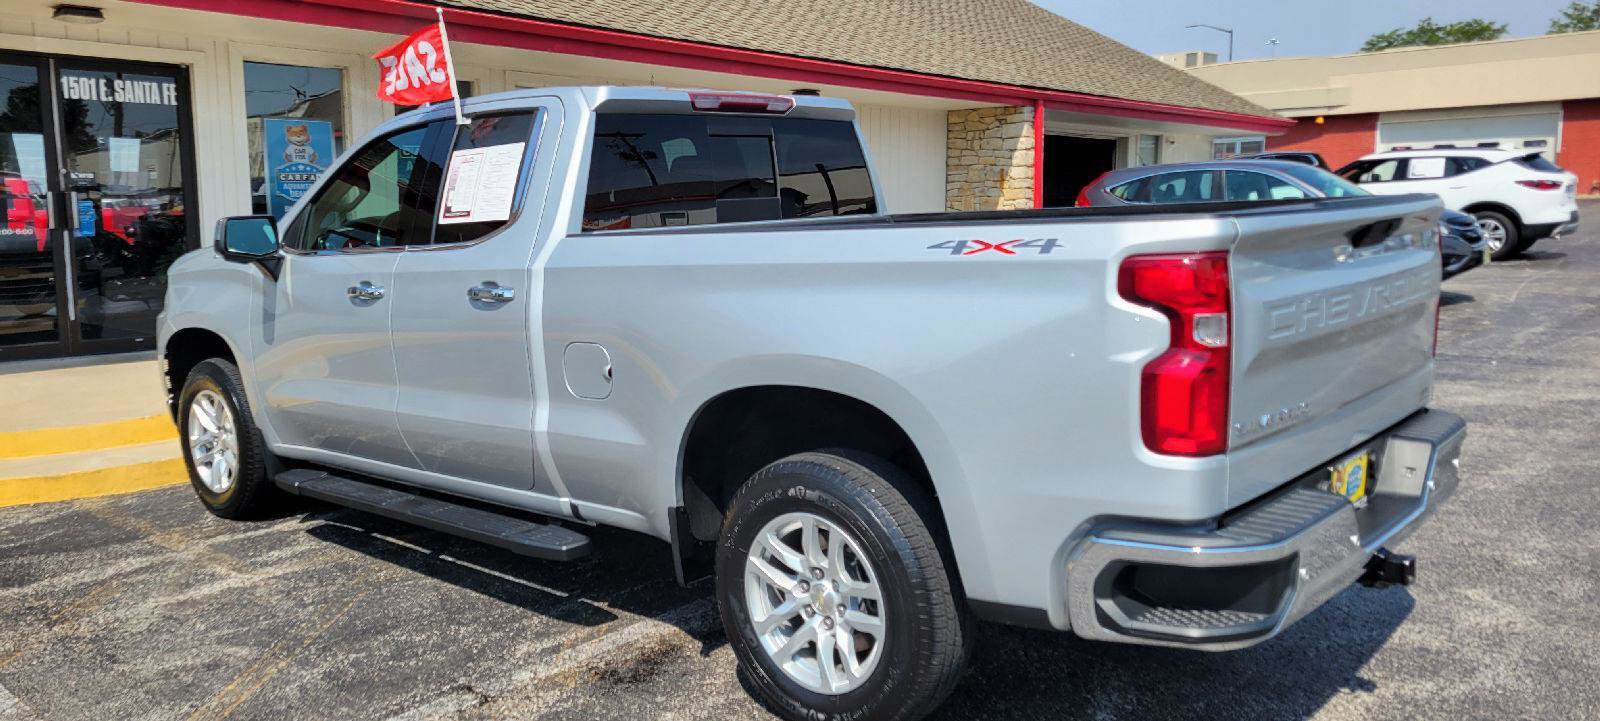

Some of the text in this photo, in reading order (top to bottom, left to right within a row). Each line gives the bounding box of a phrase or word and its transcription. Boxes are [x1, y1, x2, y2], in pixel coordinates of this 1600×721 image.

[61, 76, 178, 106] 1501 E. SANTA FE
